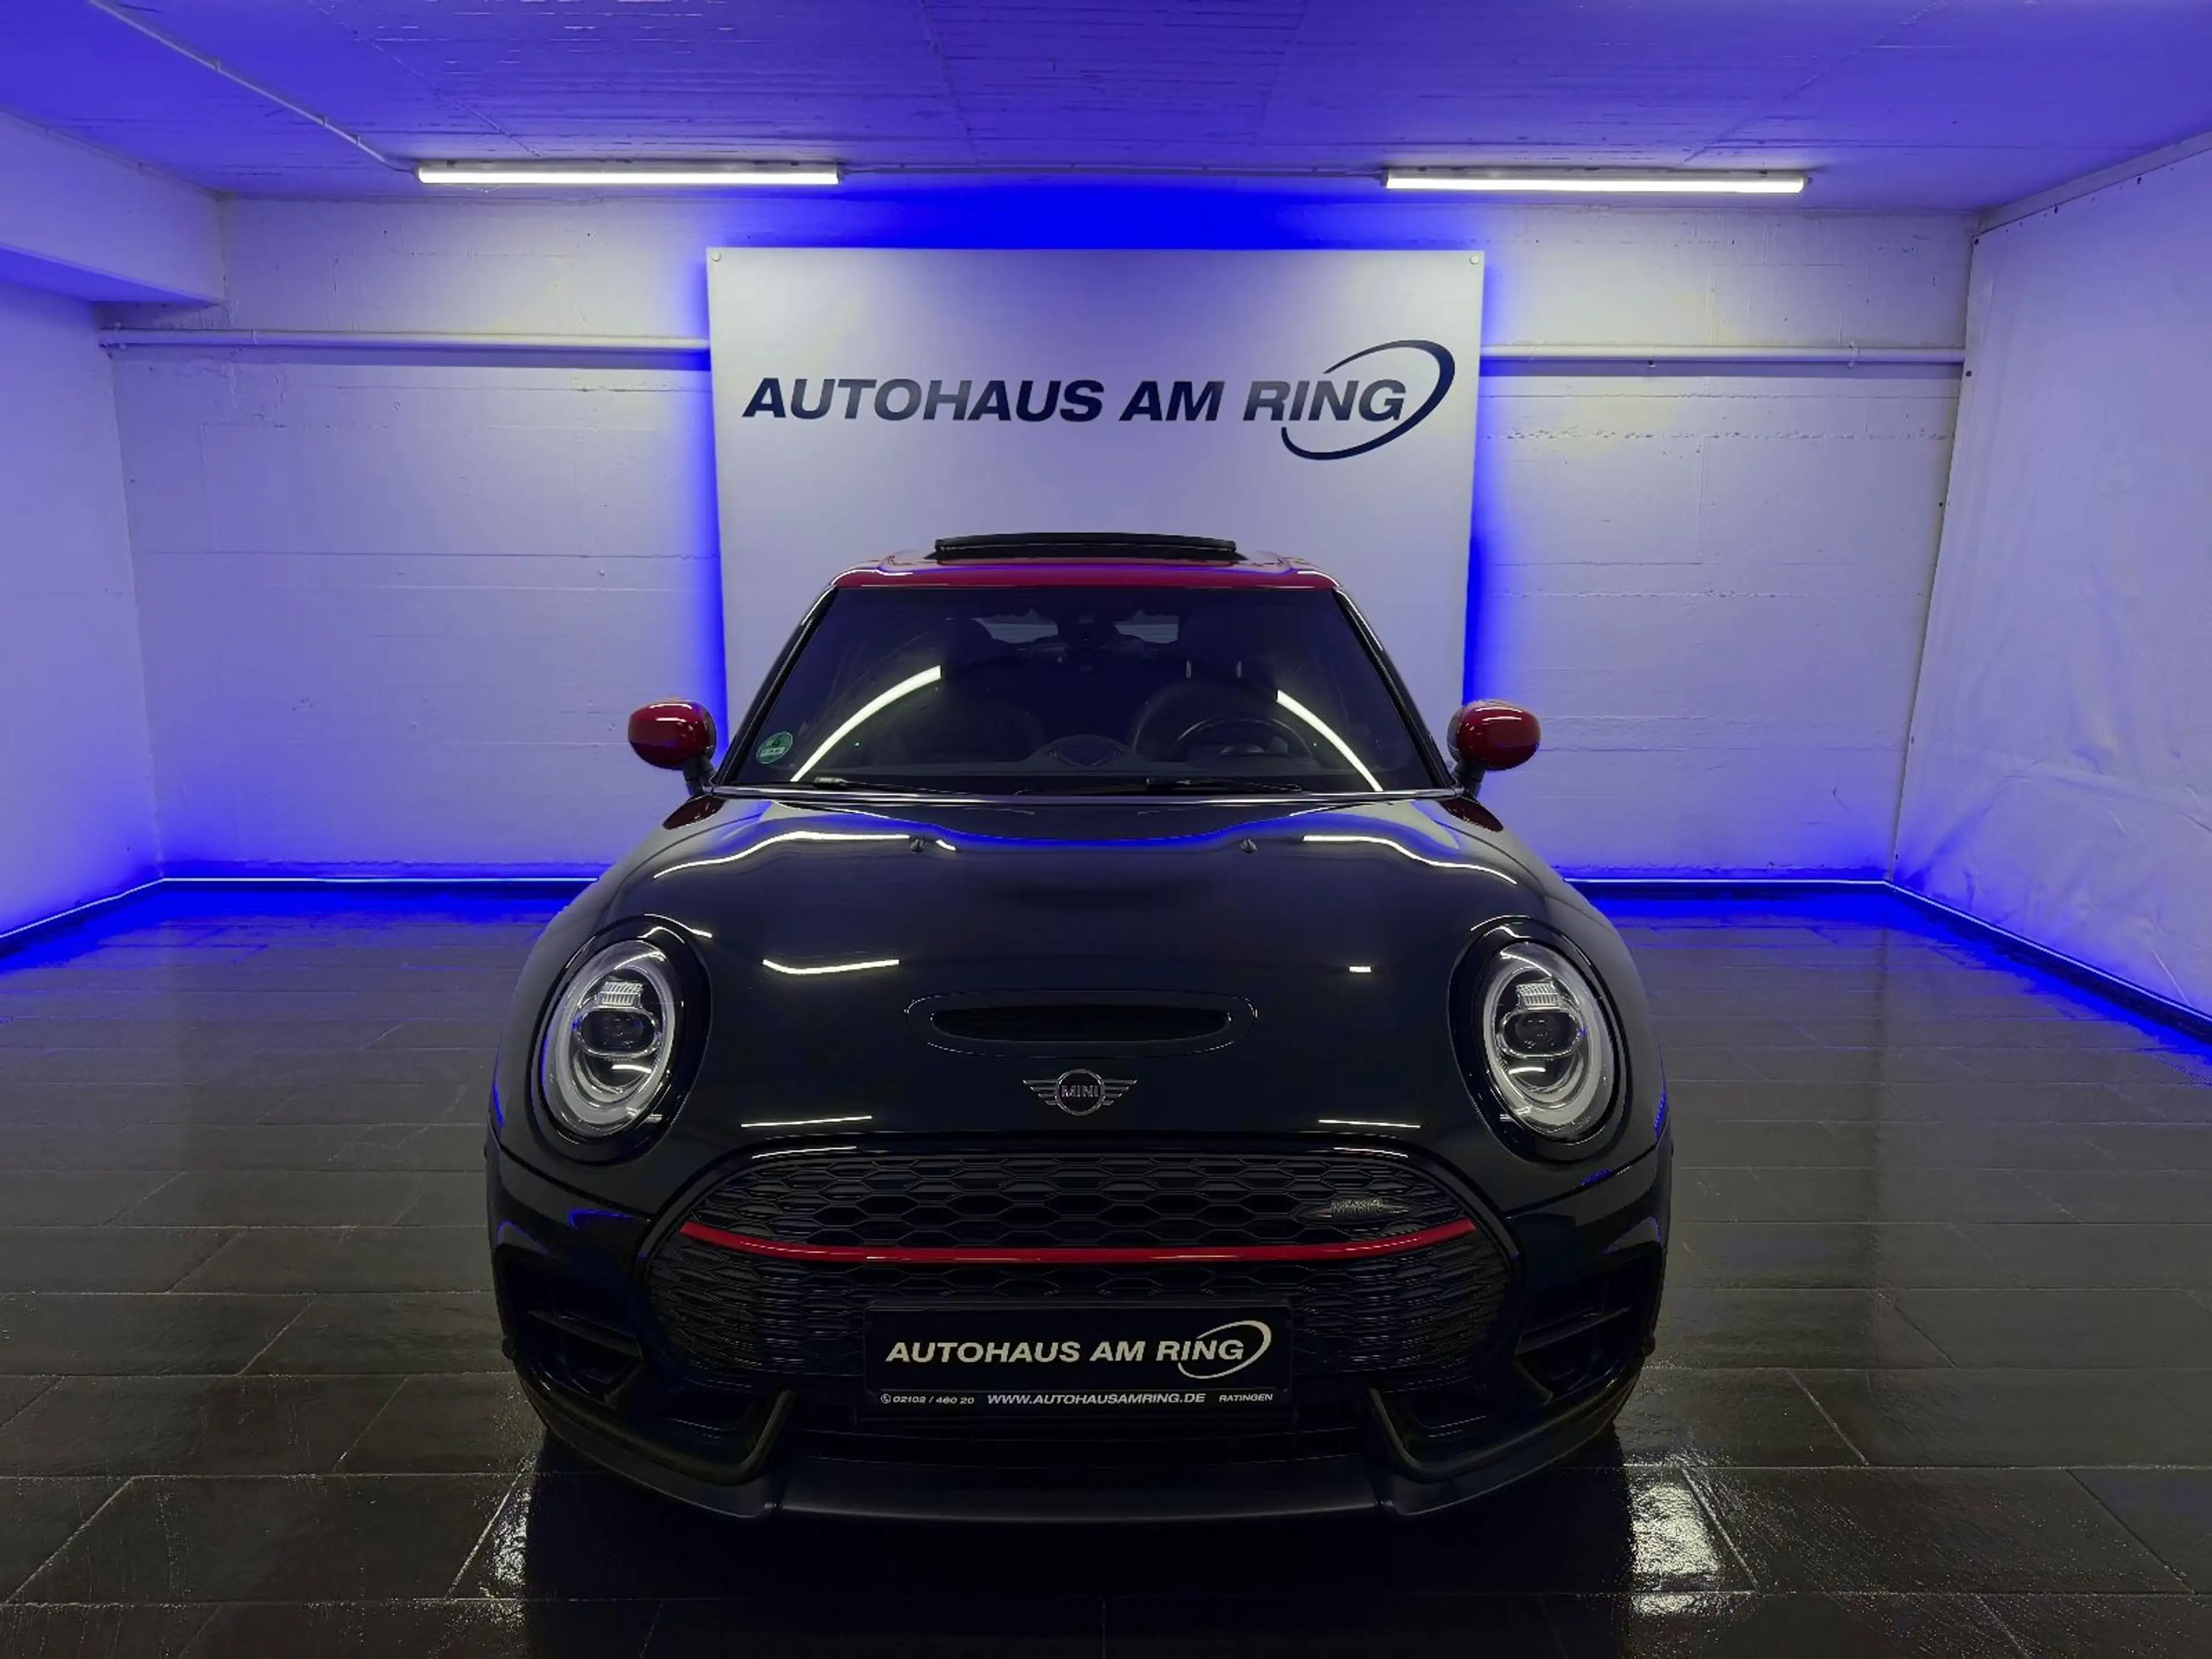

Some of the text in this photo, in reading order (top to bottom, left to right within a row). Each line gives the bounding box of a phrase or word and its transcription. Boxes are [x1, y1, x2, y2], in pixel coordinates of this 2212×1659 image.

[742, 377, 1407, 423] AUTOHAUS AM RING
[1061, 1085, 1100, 1097] MINI
[885, 1339, 1245, 1363] AUTOHAUS AM RING
[892, 1396, 926, 1404] 02102
[935, 1396, 958, 1404] 460
[987, 1393, 1206, 1405] WWW.AUTOHAUSAMRING.DE
[1219, 1393, 1274, 1403] RATINGEN
